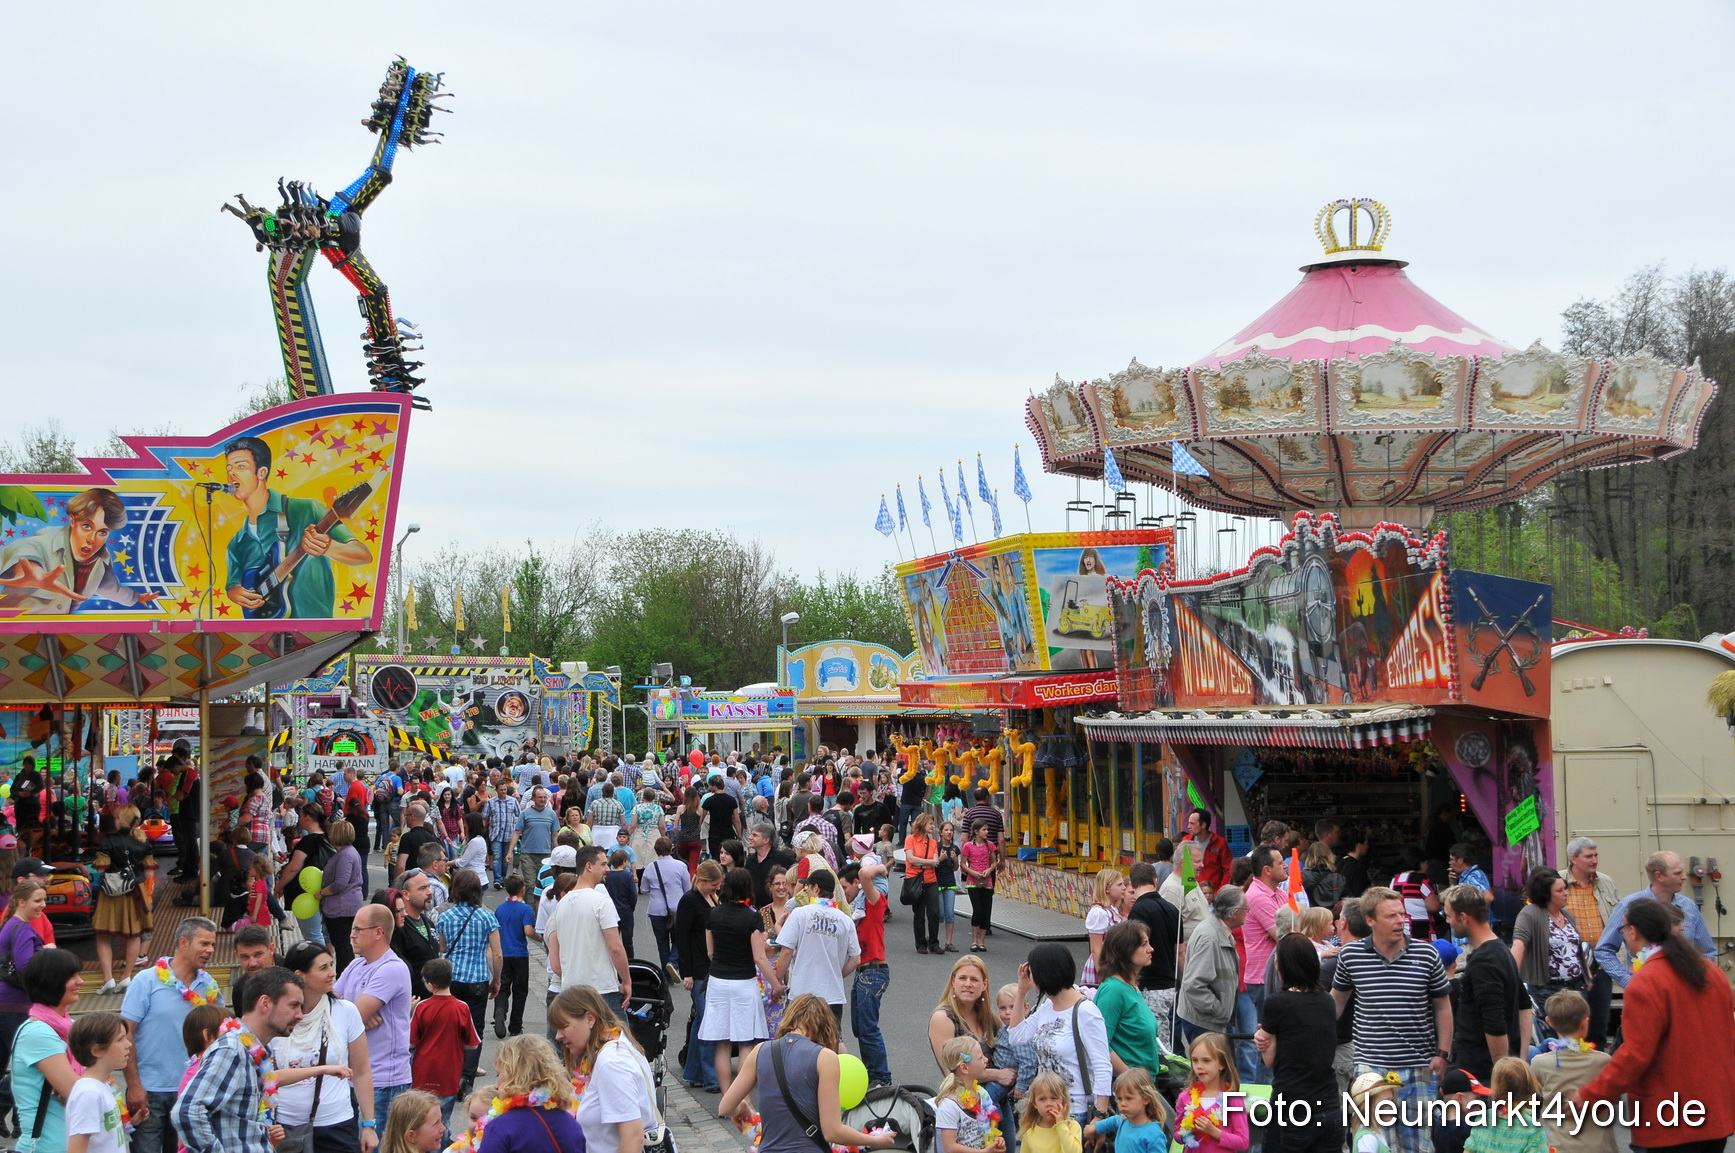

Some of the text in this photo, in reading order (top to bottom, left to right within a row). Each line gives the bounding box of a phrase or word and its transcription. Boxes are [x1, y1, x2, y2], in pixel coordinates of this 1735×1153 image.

[1386, 569, 1450, 688] EXPRESS
[472, 675, 524, 686] NO LIMIT
[545, 677, 566, 688] SKY
[1036, 681, 1119, 698] "Workers dan
[419, 708, 440, 721] WE
[710, 702, 769, 718] KASSE
[314, 759, 375, 768] HARMANN
[812, 915, 838, 934] 305
